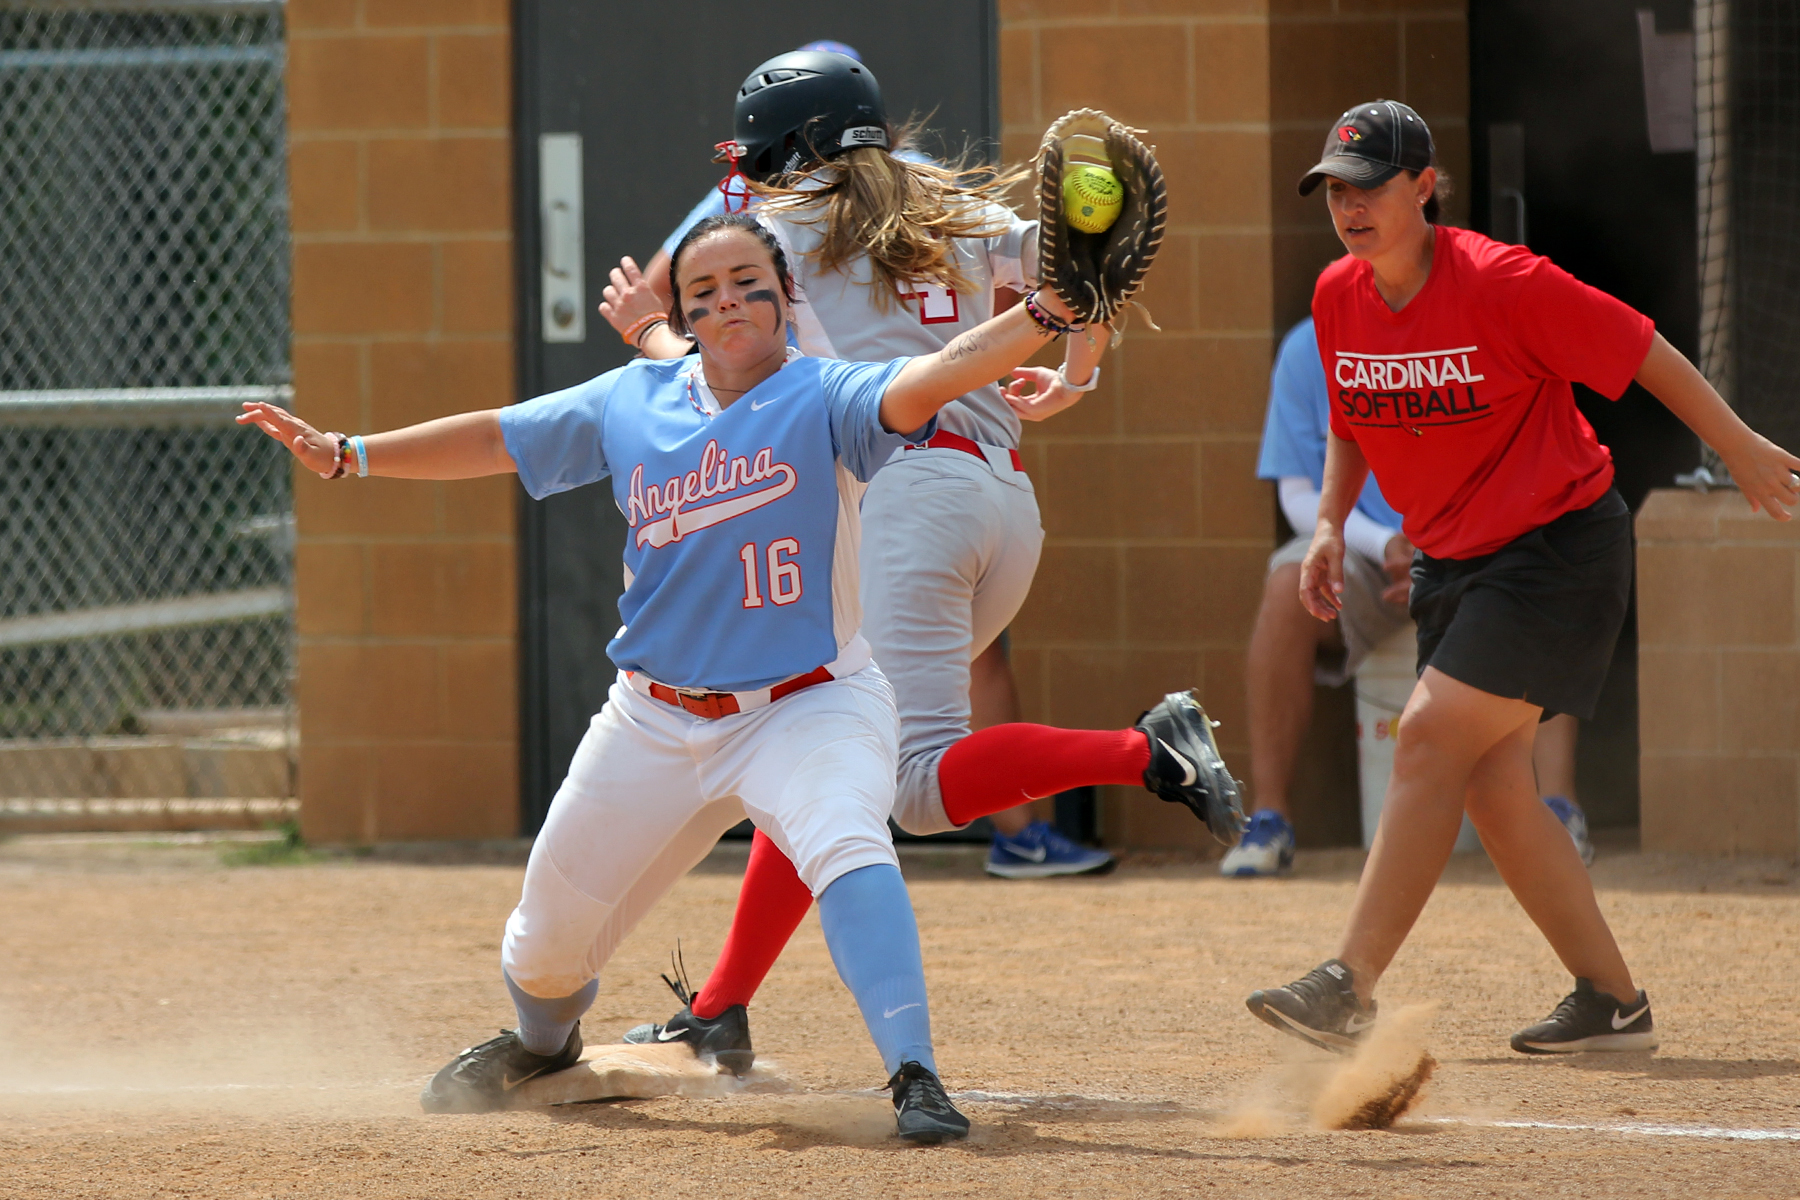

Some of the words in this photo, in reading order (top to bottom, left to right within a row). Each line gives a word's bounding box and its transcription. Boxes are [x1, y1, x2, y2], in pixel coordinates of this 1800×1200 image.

[1335, 354, 1485, 390] CARDINAL
[1339, 385, 1491, 418] SOFTBALL
[627, 438, 775, 542] Angelina
[739, 536, 803, 608] 16
